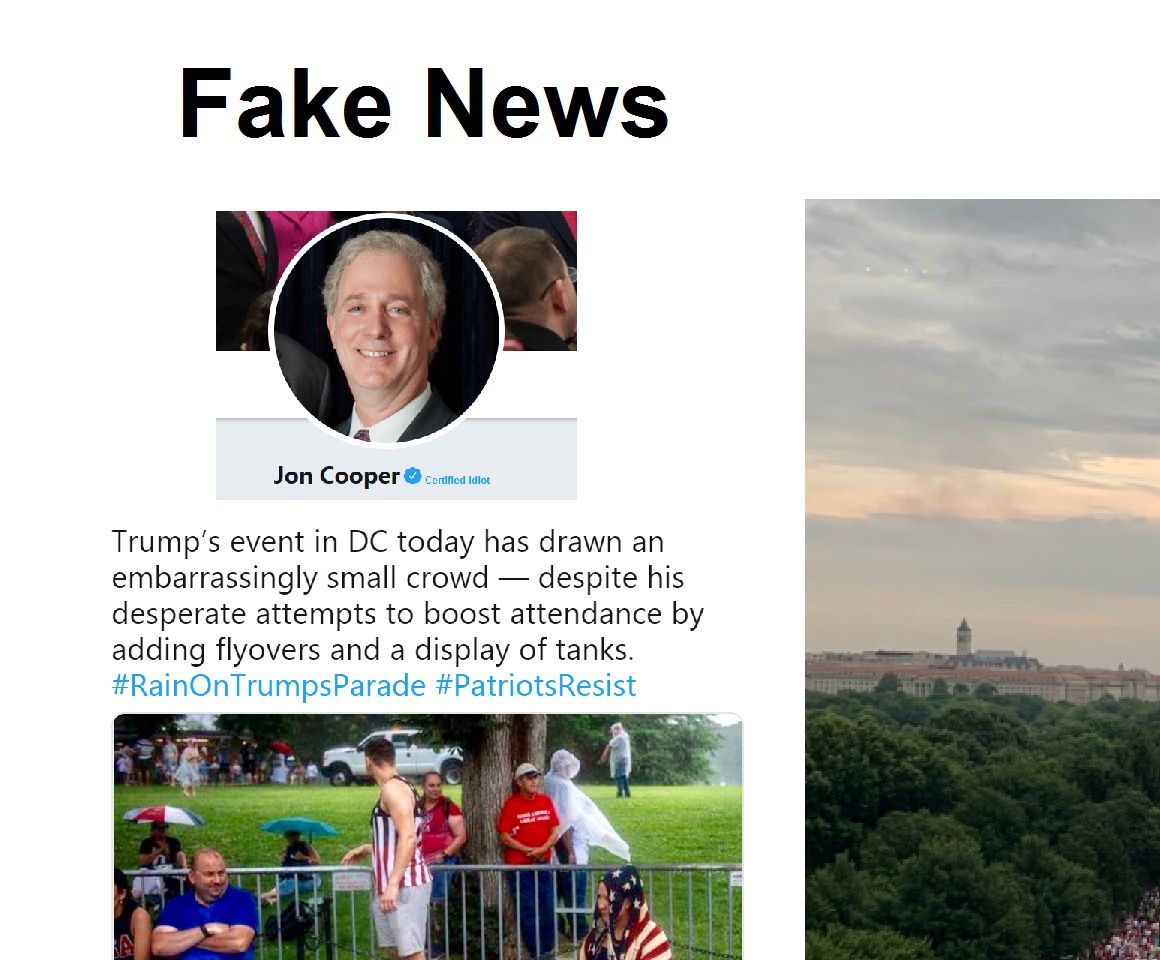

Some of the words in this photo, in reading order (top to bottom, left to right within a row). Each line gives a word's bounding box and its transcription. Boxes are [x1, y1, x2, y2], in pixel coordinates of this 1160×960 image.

[273, 465, 313, 485] Jon
[320, 465, 401, 490] Cooper
[425, 475, 467, 485] Certified
[468, 475, 491, 485] Idiot
[112, 530, 219, 559] Trump’s
[230, 531, 305, 553] event
[315, 528, 337, 553] in
[349, 529, 388, 553] DC
[397, 529, 475, 559] today
[485, 528, 529, 553] has
[539, 528, 622, 553] drawn
[632, 535, 664, 553] an
[113, 565, 318, 595] embarrassingly
[327, 564, 396, 589] small
[406, 564, 488, 589] crowd
[539, 565, 637, 595] despite
[648, 564, 685, 589] his
[113, 601, 246, 631] desperate
[257, 604, 375, 631] attempts
[385, 603, 414, 625] to
[425, 600, 501, 625] boost
[510, 600, 662, 625] attendance
[673, 601, 704, 631] by
[113, 637, 204, 667] adding
[216, 637, 320, 667] flyovers
[330, 636, 379, 661] and
[390, 643, 404, 661] a
[416, 637, 510, 667] display
[519, 636, 548, 661] of
[555, 636, 634, 661] tanks.
[112, 673, 425, 703] #RainOnTrumpsParade
[435, 672, 637, 697] #PatriotsResist
